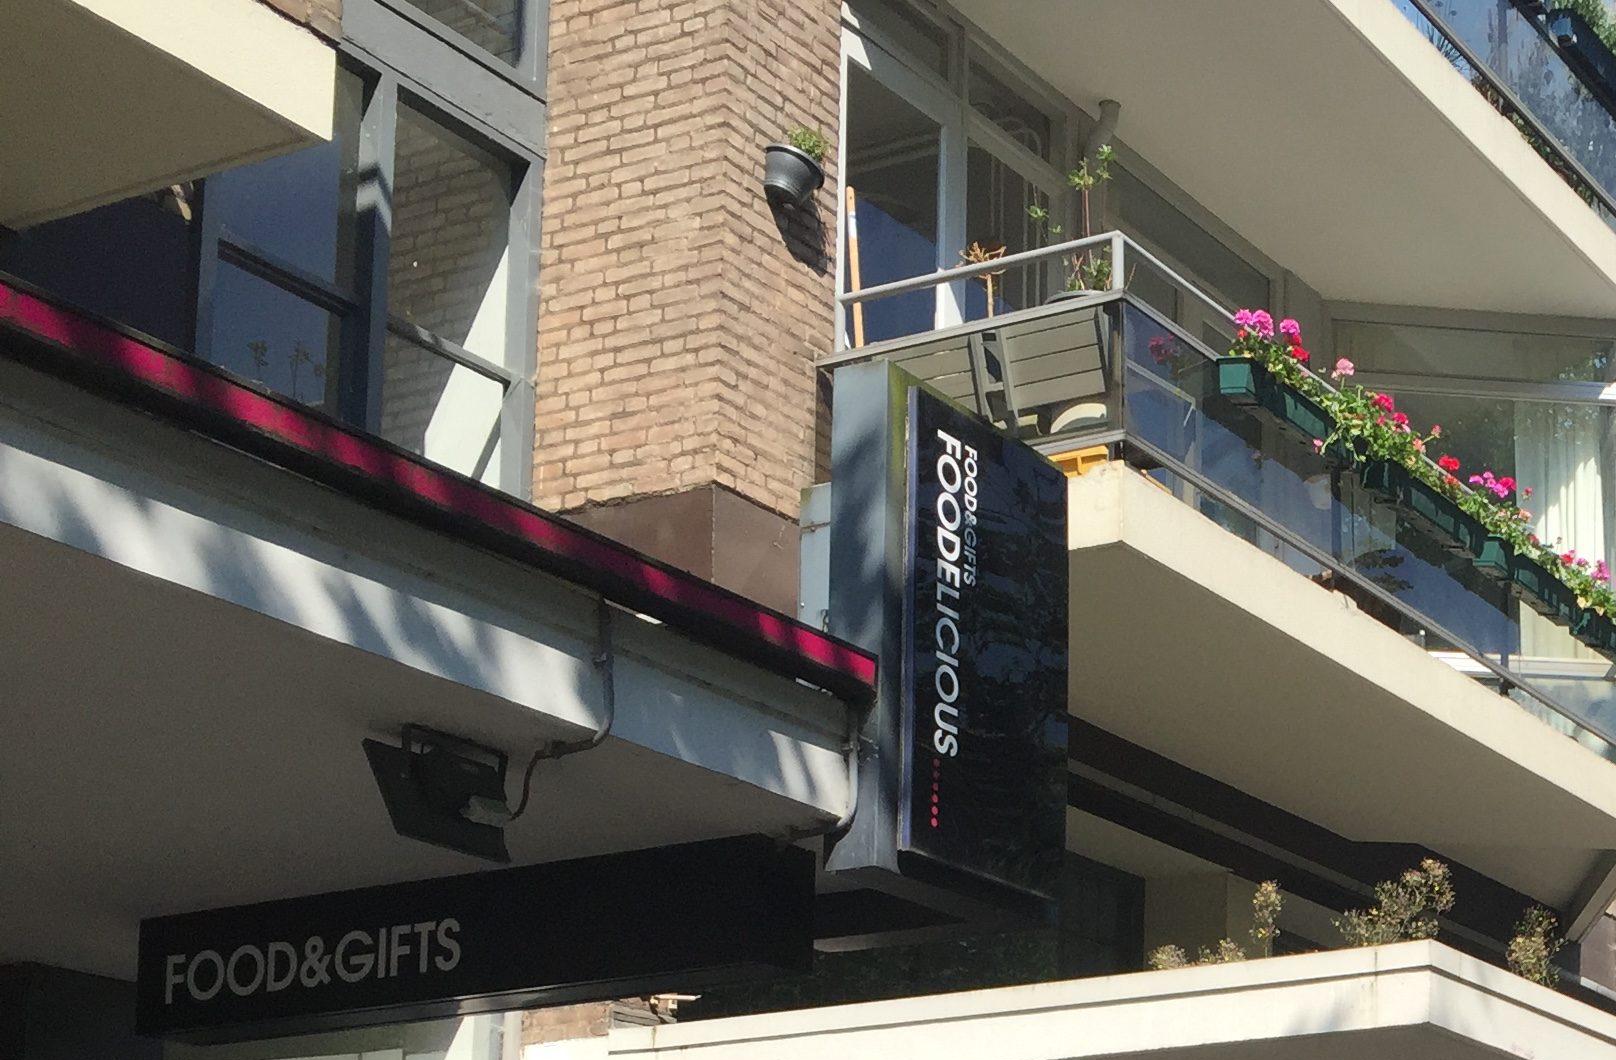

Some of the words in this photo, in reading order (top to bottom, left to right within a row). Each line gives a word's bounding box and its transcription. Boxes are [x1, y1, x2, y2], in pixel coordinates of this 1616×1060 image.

[963, 443, 978, 586] FOOD&GIFTS
[933, 428, 963, 758] FOODELICIOUS
[163, 917, 461, 1005] FOOD&GIFTS
